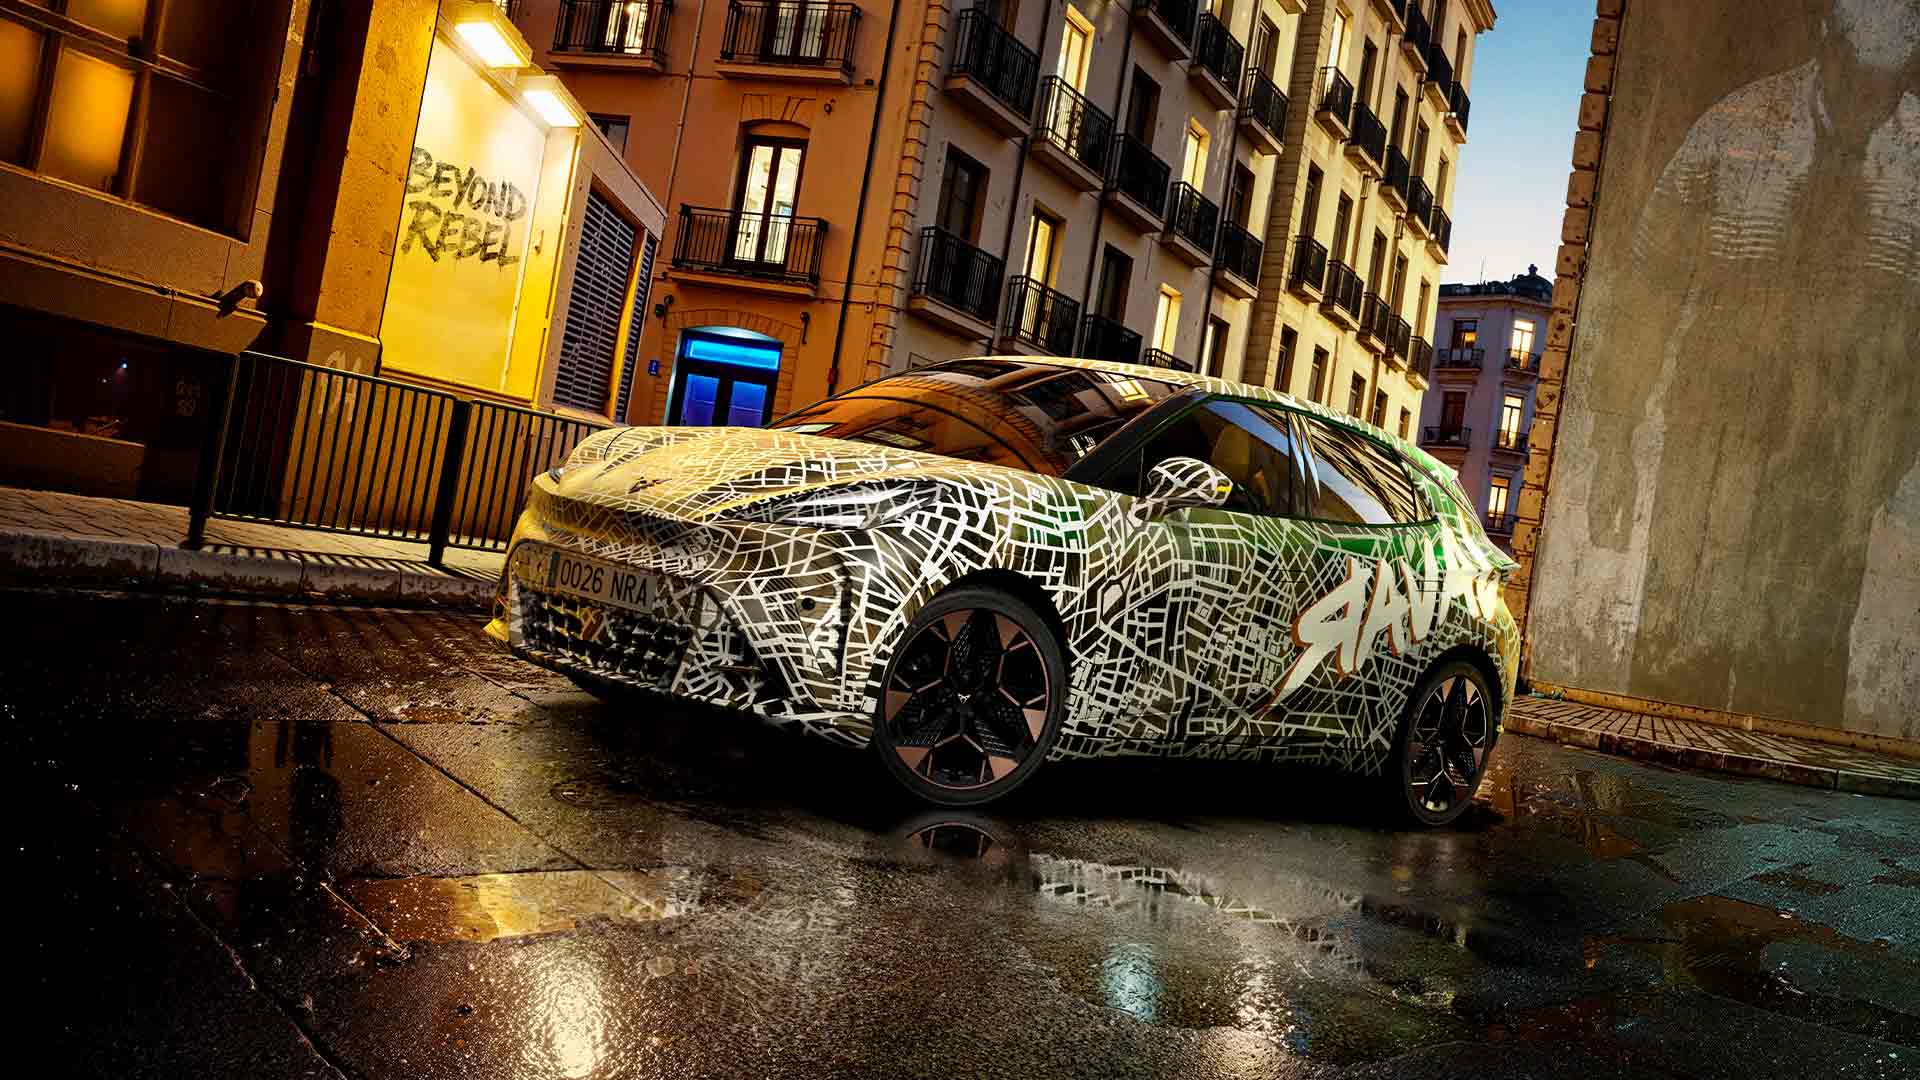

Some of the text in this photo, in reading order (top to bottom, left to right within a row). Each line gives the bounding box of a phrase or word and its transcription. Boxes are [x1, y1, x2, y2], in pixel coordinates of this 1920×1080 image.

[407, 146, 527, 221] BEYOND
[401, 201, 520, 267] REBEL
[560, 558, 647, 607] 0026 NRA
